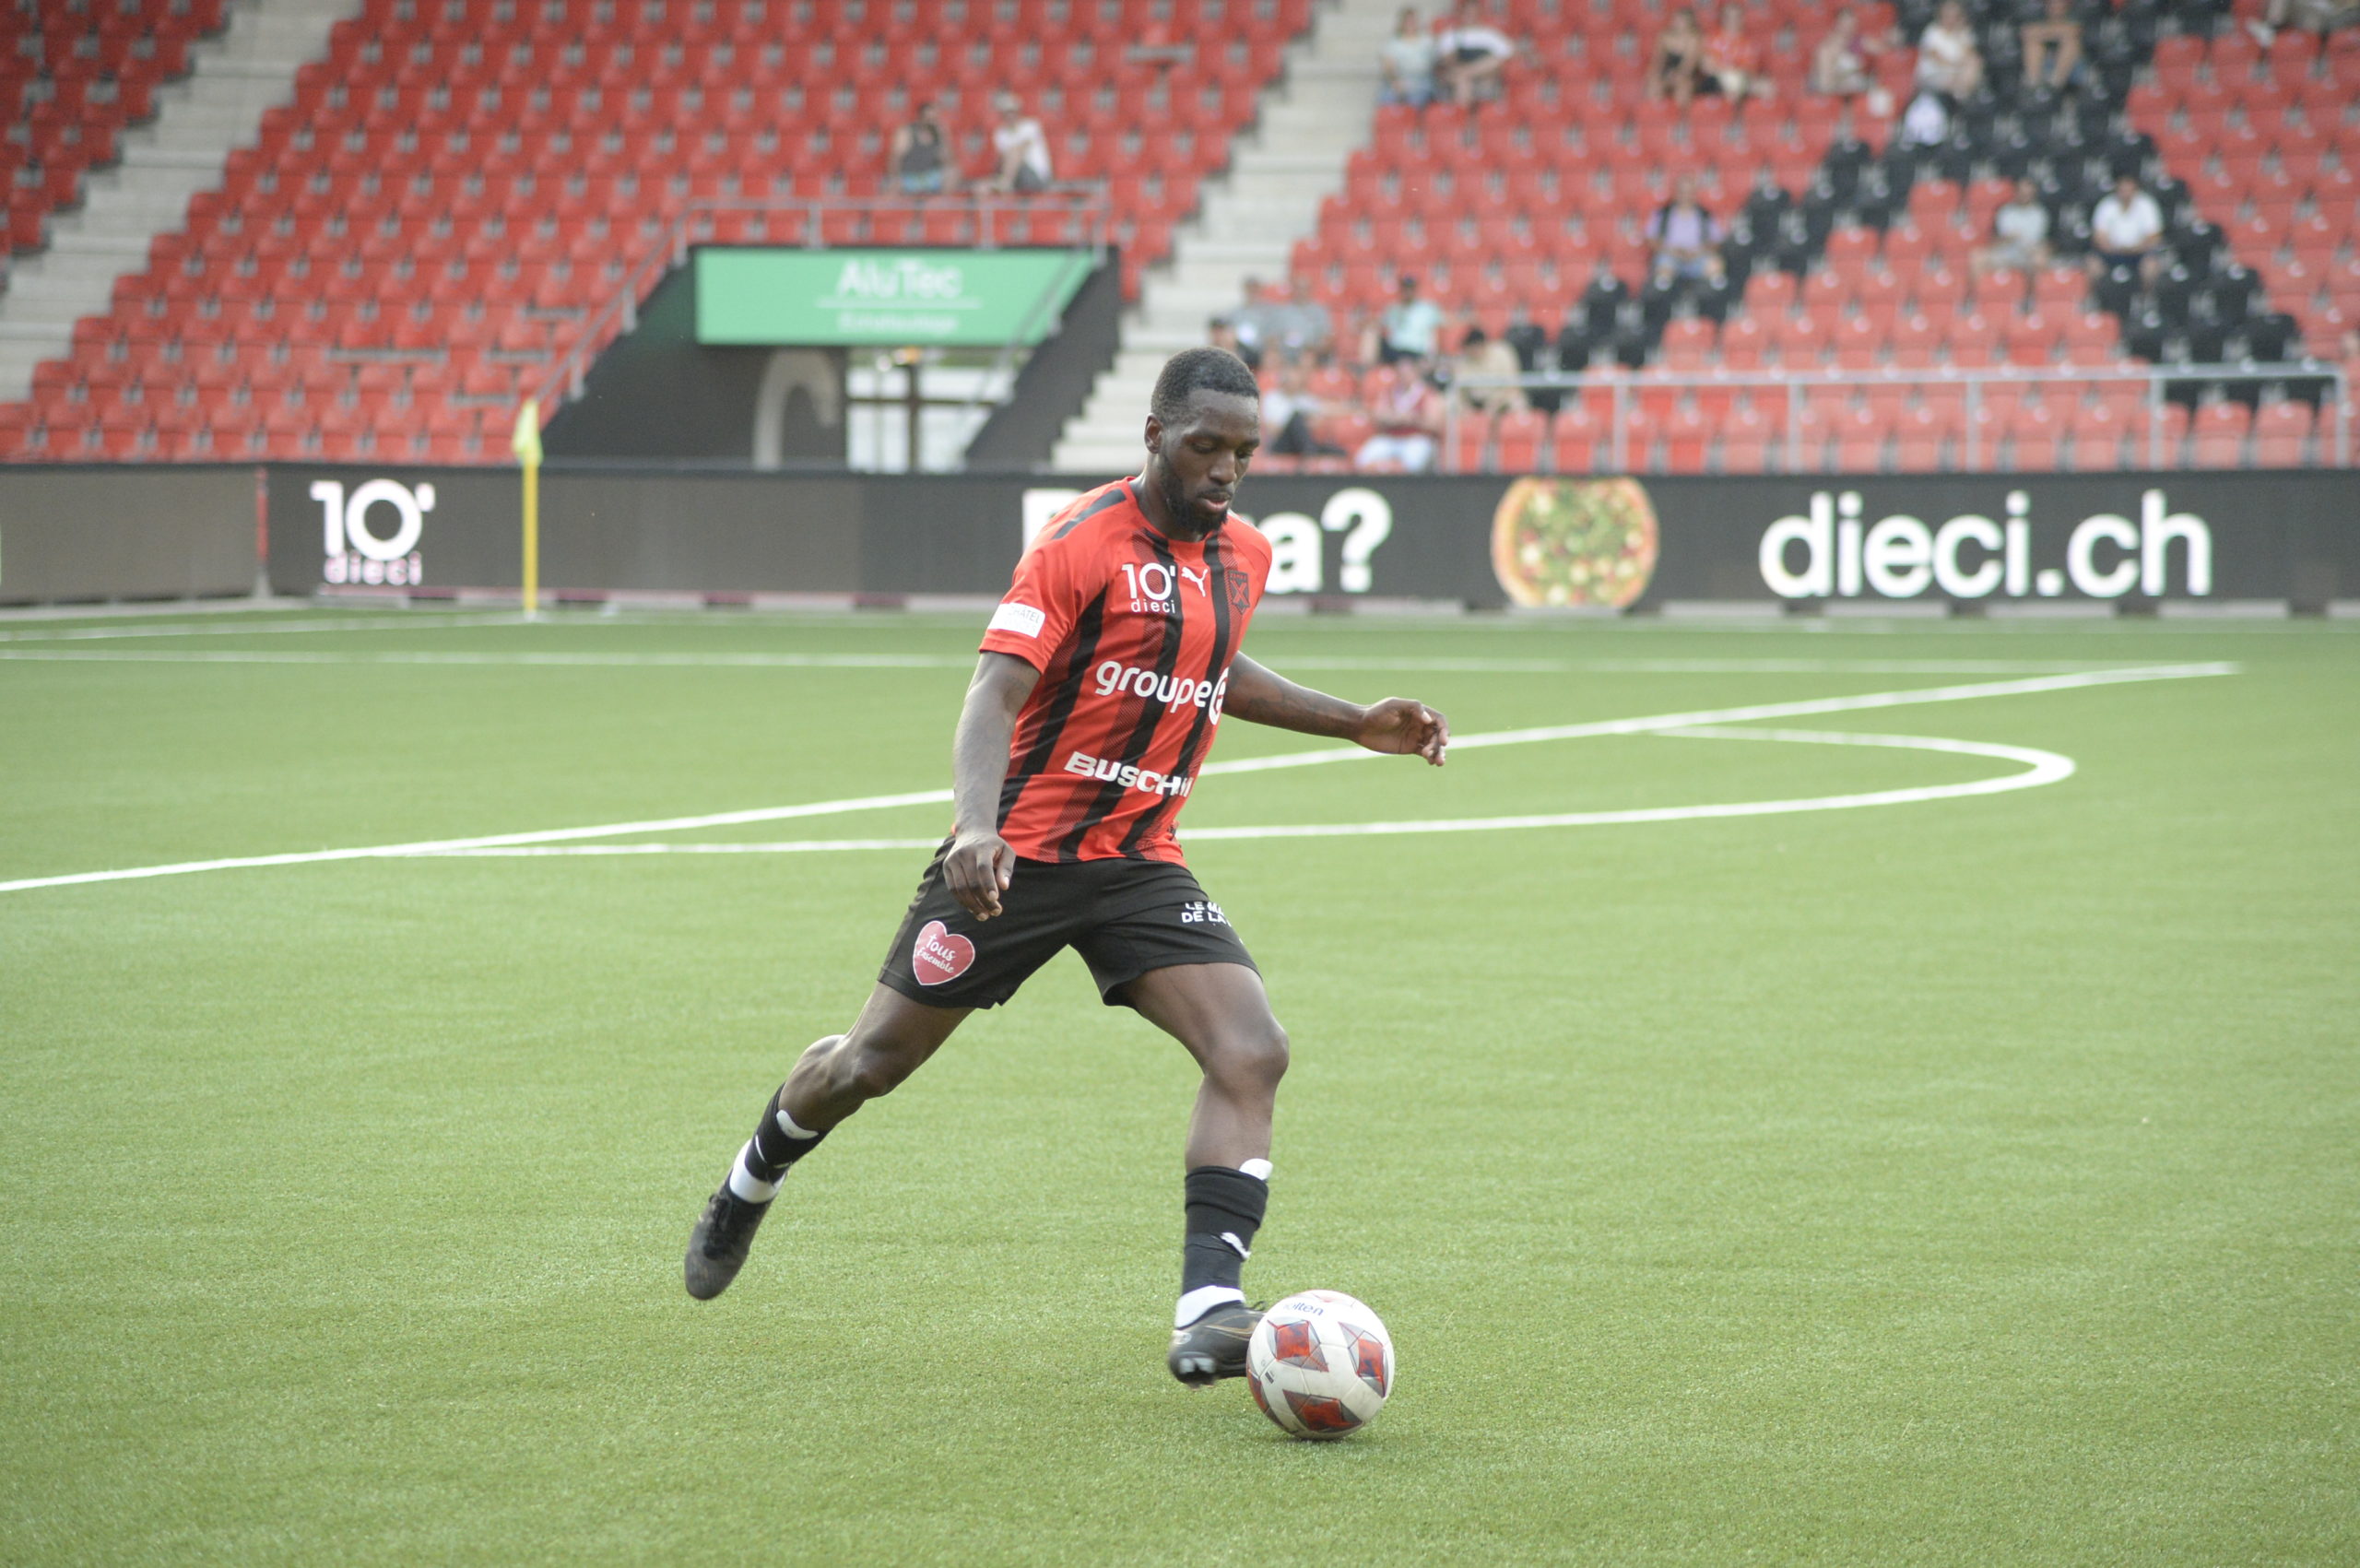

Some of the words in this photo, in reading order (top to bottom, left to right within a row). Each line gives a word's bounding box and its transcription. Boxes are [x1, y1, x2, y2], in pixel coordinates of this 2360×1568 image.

[835, 258, 962, 298] AluTec
[1758, 489, 2212, 598] dieci.ch
[324, 550, 422, 585] dieci
[1130, 598, 1175, 614] dieci
[1185, 901, 1205, 911] LE
[1181, 911, 1204, 924] DE
[1283, 1301, 1325, 1316] lten
